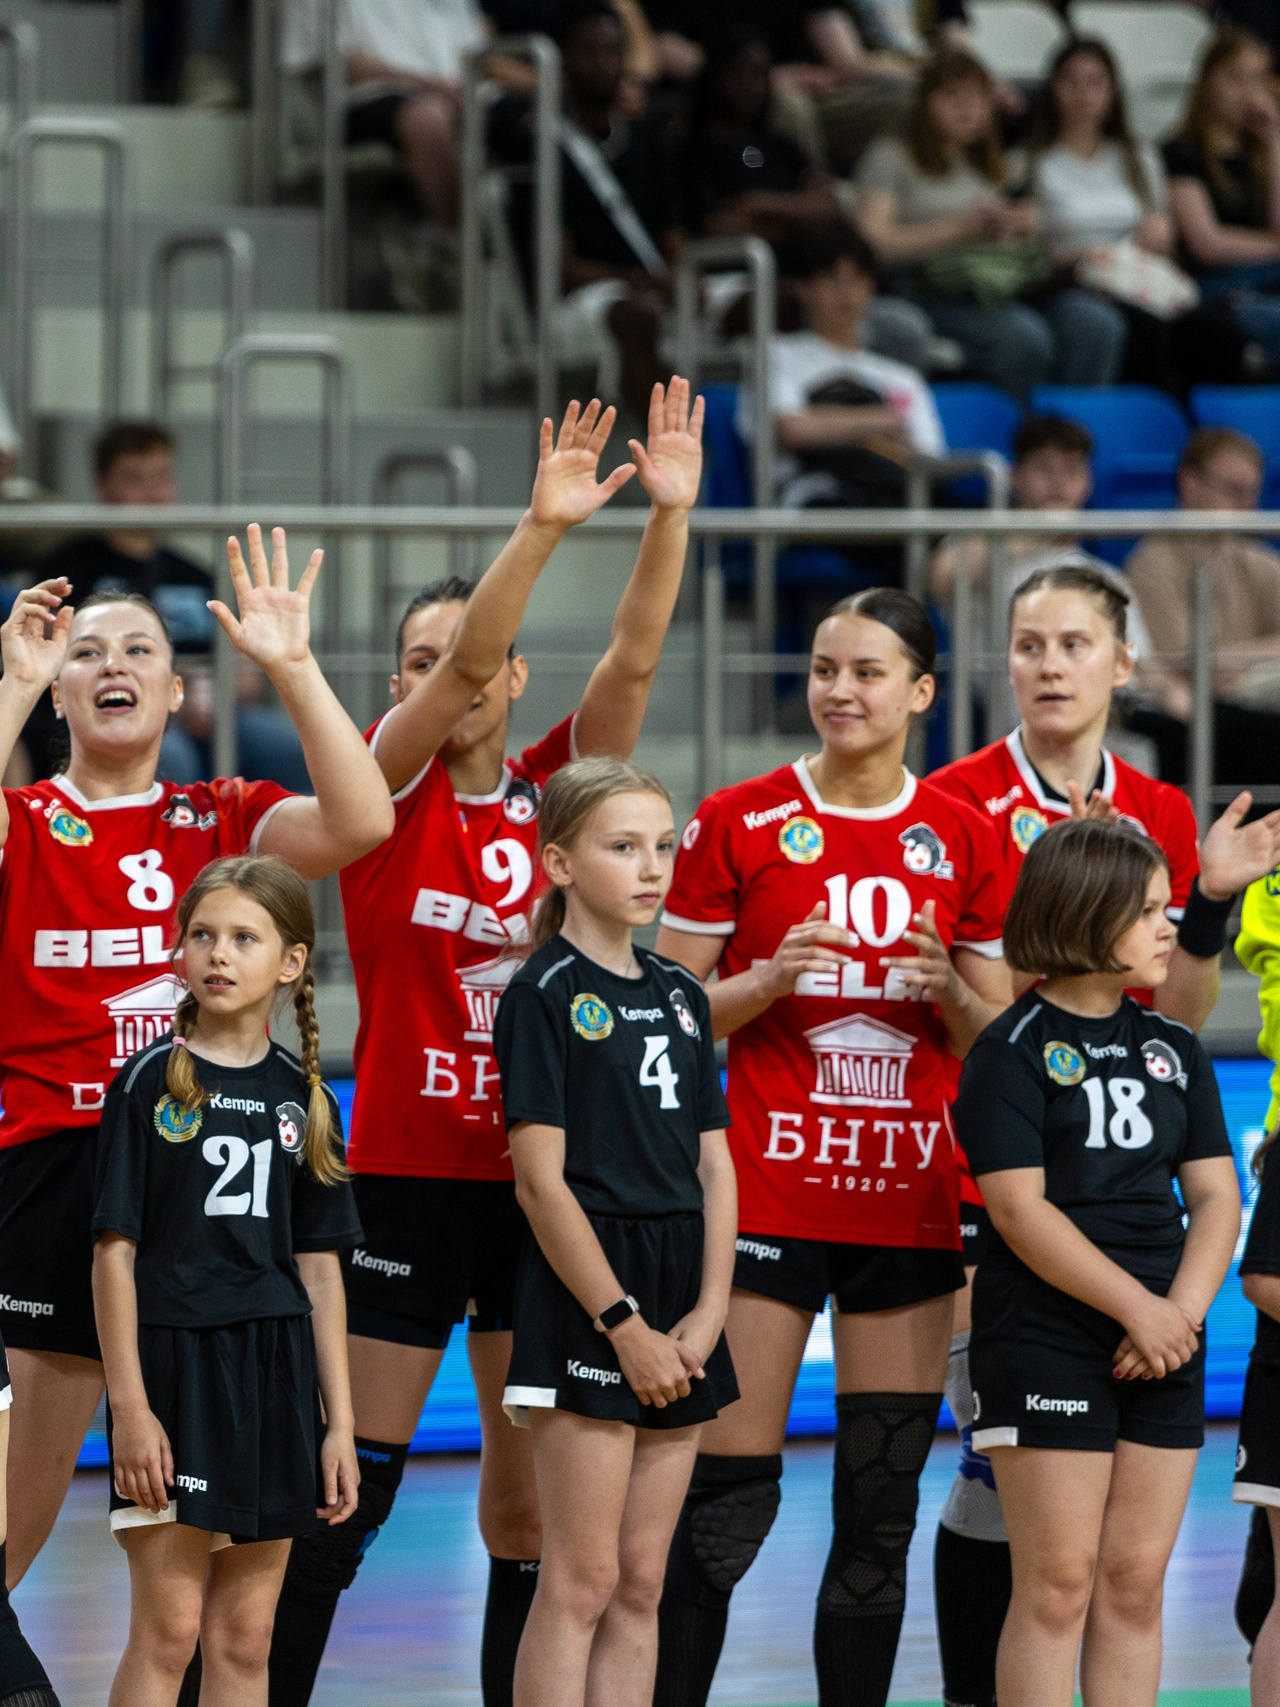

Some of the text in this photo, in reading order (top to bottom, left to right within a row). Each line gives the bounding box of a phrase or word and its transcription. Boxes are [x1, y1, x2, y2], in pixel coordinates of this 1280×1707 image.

[743, 799, 802, 830] Kempa
[118, 849, 175, 911] 8
[481, 838, 532, 908] 9
[824, 873, 912, 948] 10
[34, 925, 184, 968] BEL
[640, 1035, 680, 1109] 4
[209, 1093, 265, 1115] Kempa
[1081, 1076, 1154, 1149] 18
[763, 1111, 941, 1170] БНТУ
[202, 1135, 273, 1218] 21
[831, 1174, 886, 1192] 1920
[352, 1248, 412, 1277] Kempa
[736, 1238, 782, 1261] empa
[567, 1359, 621, 1386] Kempa
[1026, 1394, 1089, 1416] Kempa
[176, 1475, 208, 1493] mpa
